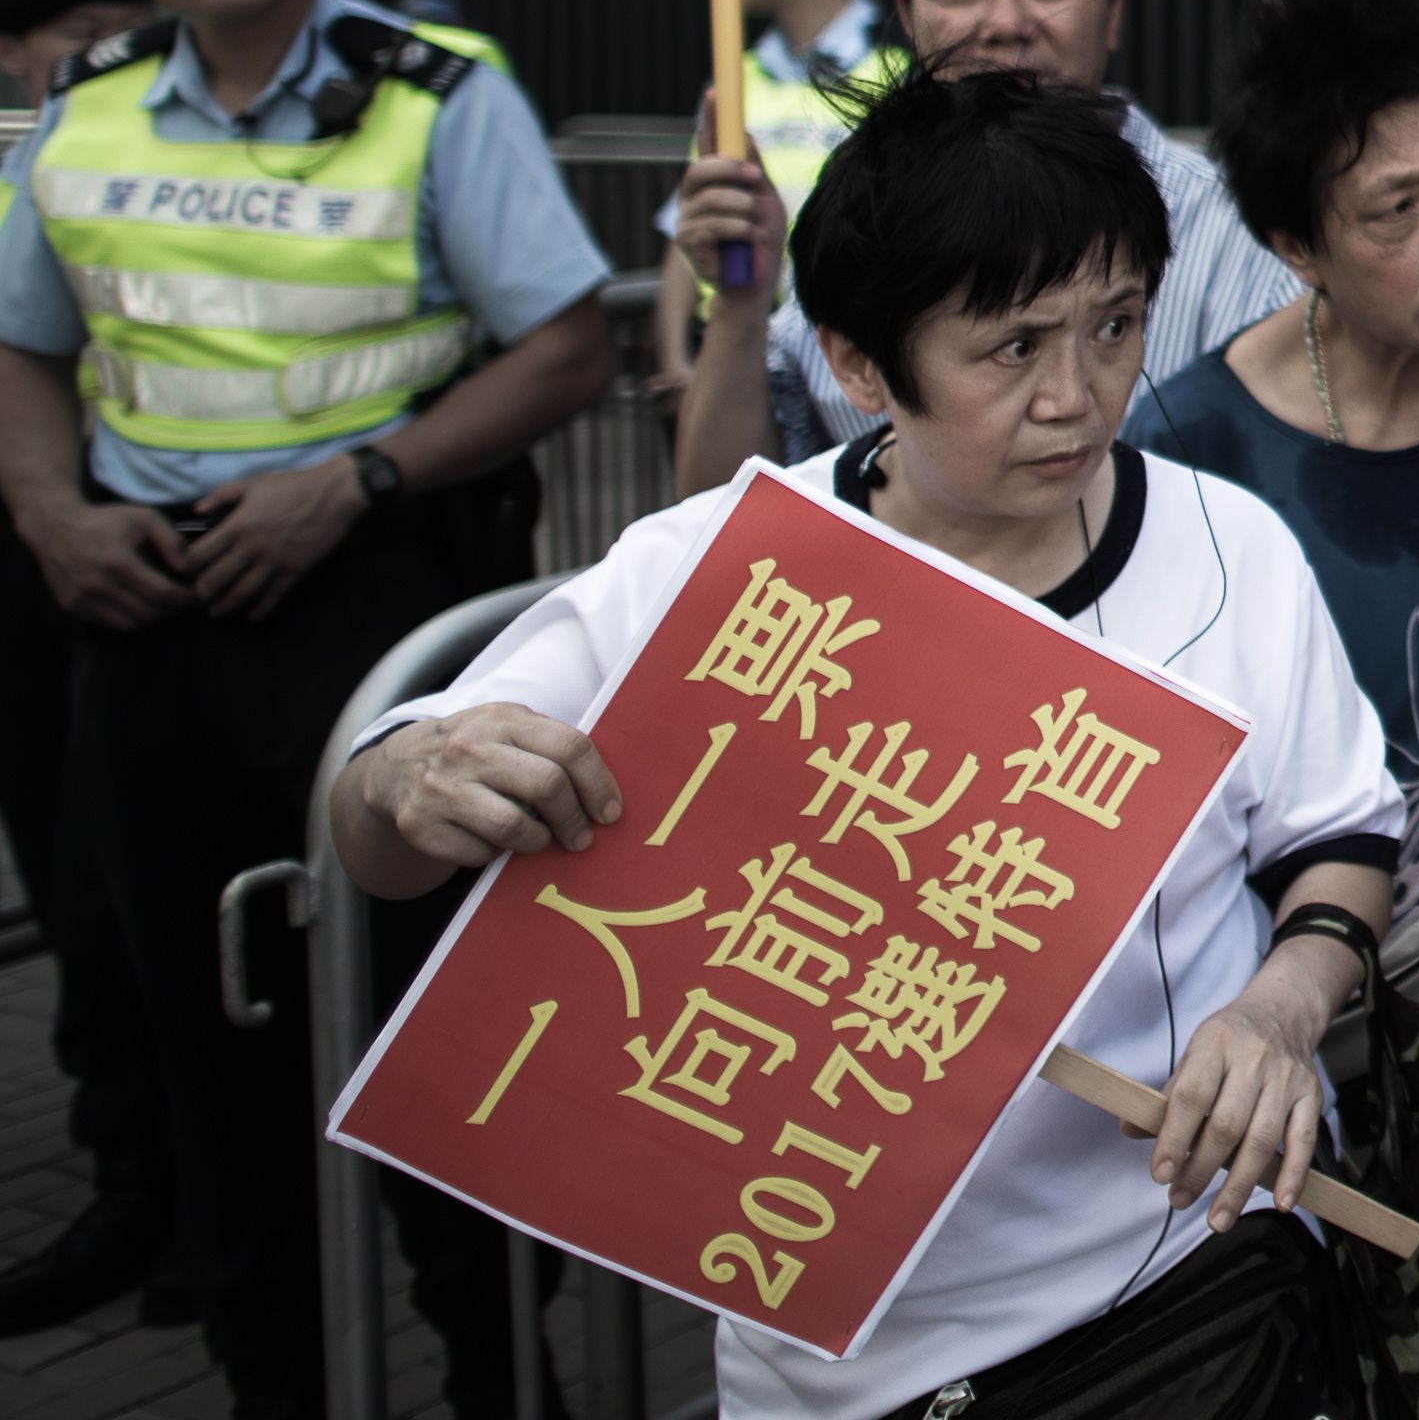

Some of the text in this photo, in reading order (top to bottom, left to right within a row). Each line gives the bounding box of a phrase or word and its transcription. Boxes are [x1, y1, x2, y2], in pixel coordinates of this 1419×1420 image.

[148, 180, 297, 228] POLICE
[466, 556, 881, 1125] 一人一票
[616, 719, 980, 1145] 向前走
[699, 687, 1162, 1311] 2017選特首
